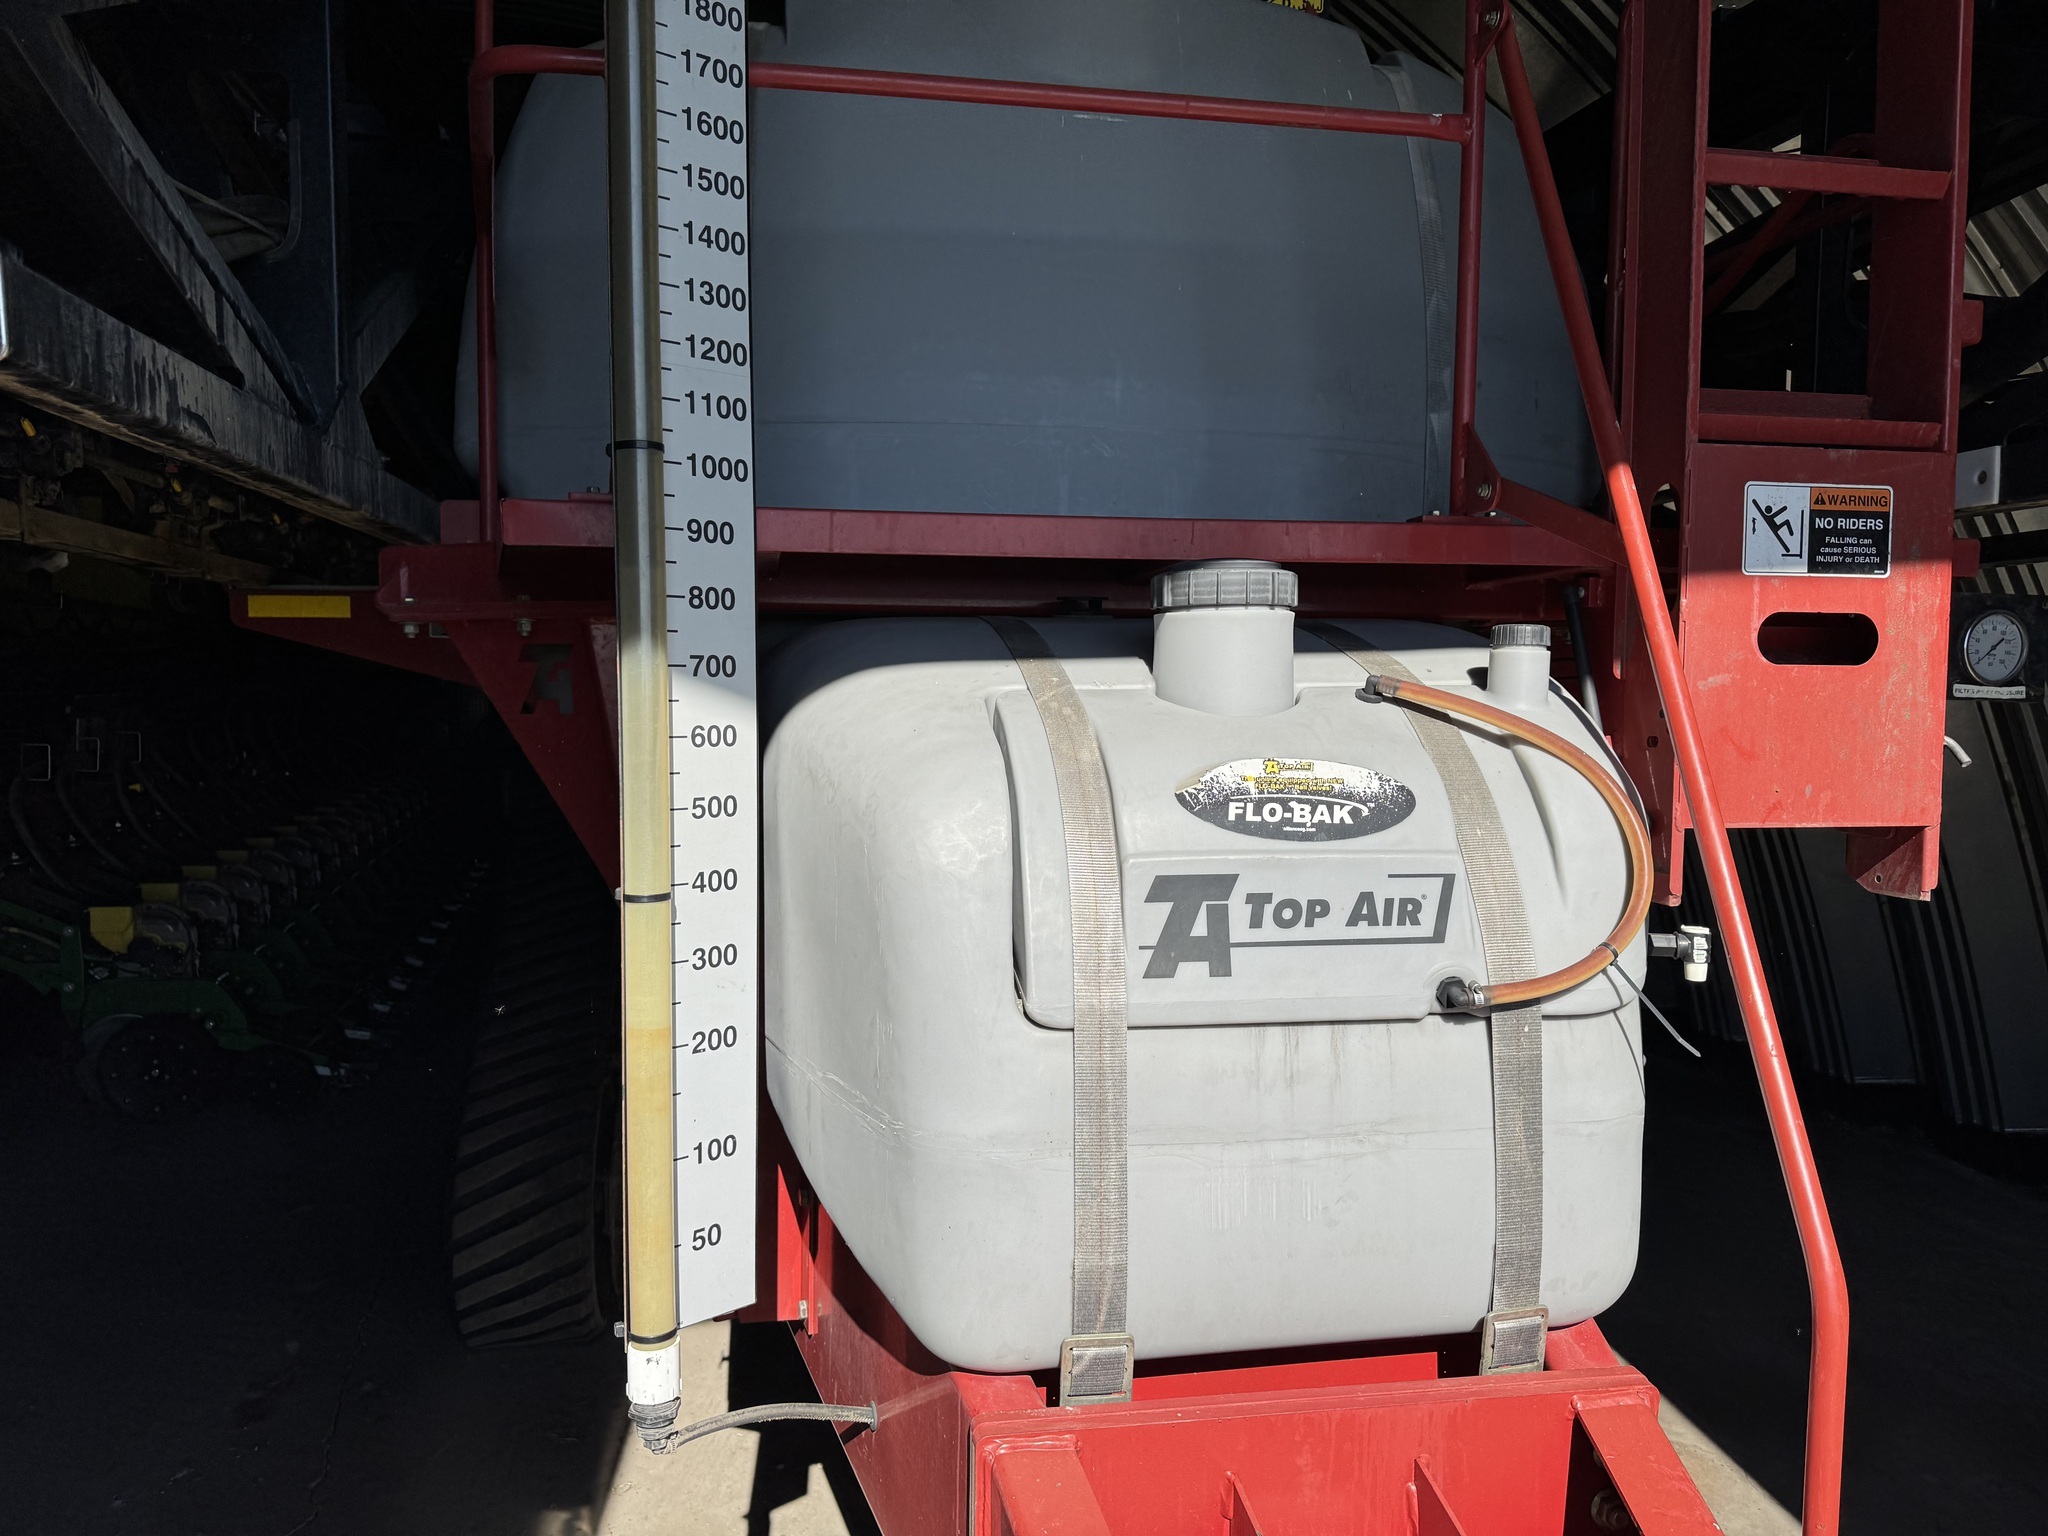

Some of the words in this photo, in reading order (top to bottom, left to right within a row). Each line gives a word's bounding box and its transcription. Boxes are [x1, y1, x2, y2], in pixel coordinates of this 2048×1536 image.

[683, 0, 743, 32] 1800
[681, 49, 743, 88] 1700
[681, 107, 744, 144] 1600
[682, 163, 745, 200] 1500
[683, 220, 746, 256] 1400
[684, 278, 747, 311] 1300
[685, 334, 748, 367] 1200
[684, 390, 747, 421] 1100
[686, 453, 749, 482] 1000
[1827, 494, 1888, 507] WARNING
[686, 518, 735, 545] 900
[1815, 517, 1835, 530] NO
[1837, 518, 1884, 531] RIDERS
[1825, 536, 1858, 545] FALLING
[1843, 546, 1877, 554] SERIOUS
[1816, 555, 1844, 563] INJURY
[1854, 555, 1880, 564] DEATH
[688, 585, 736, 611] 800
[689, 654, 737, 678] 700
[690, 724, 738, 748] 600
[691, 795, 738, 820] 500
[1228, 801, 1355, 825] FLO-BAK
[691, 868, 738, 893] 400
[1245, 892, 1331, 929] TOP
[691, 943, 738, 971] 300
[691, 1025, 738, 1055] 200
[693, 1134, 737, 1164] 100
[691, 1223, 722, 1251] 50
